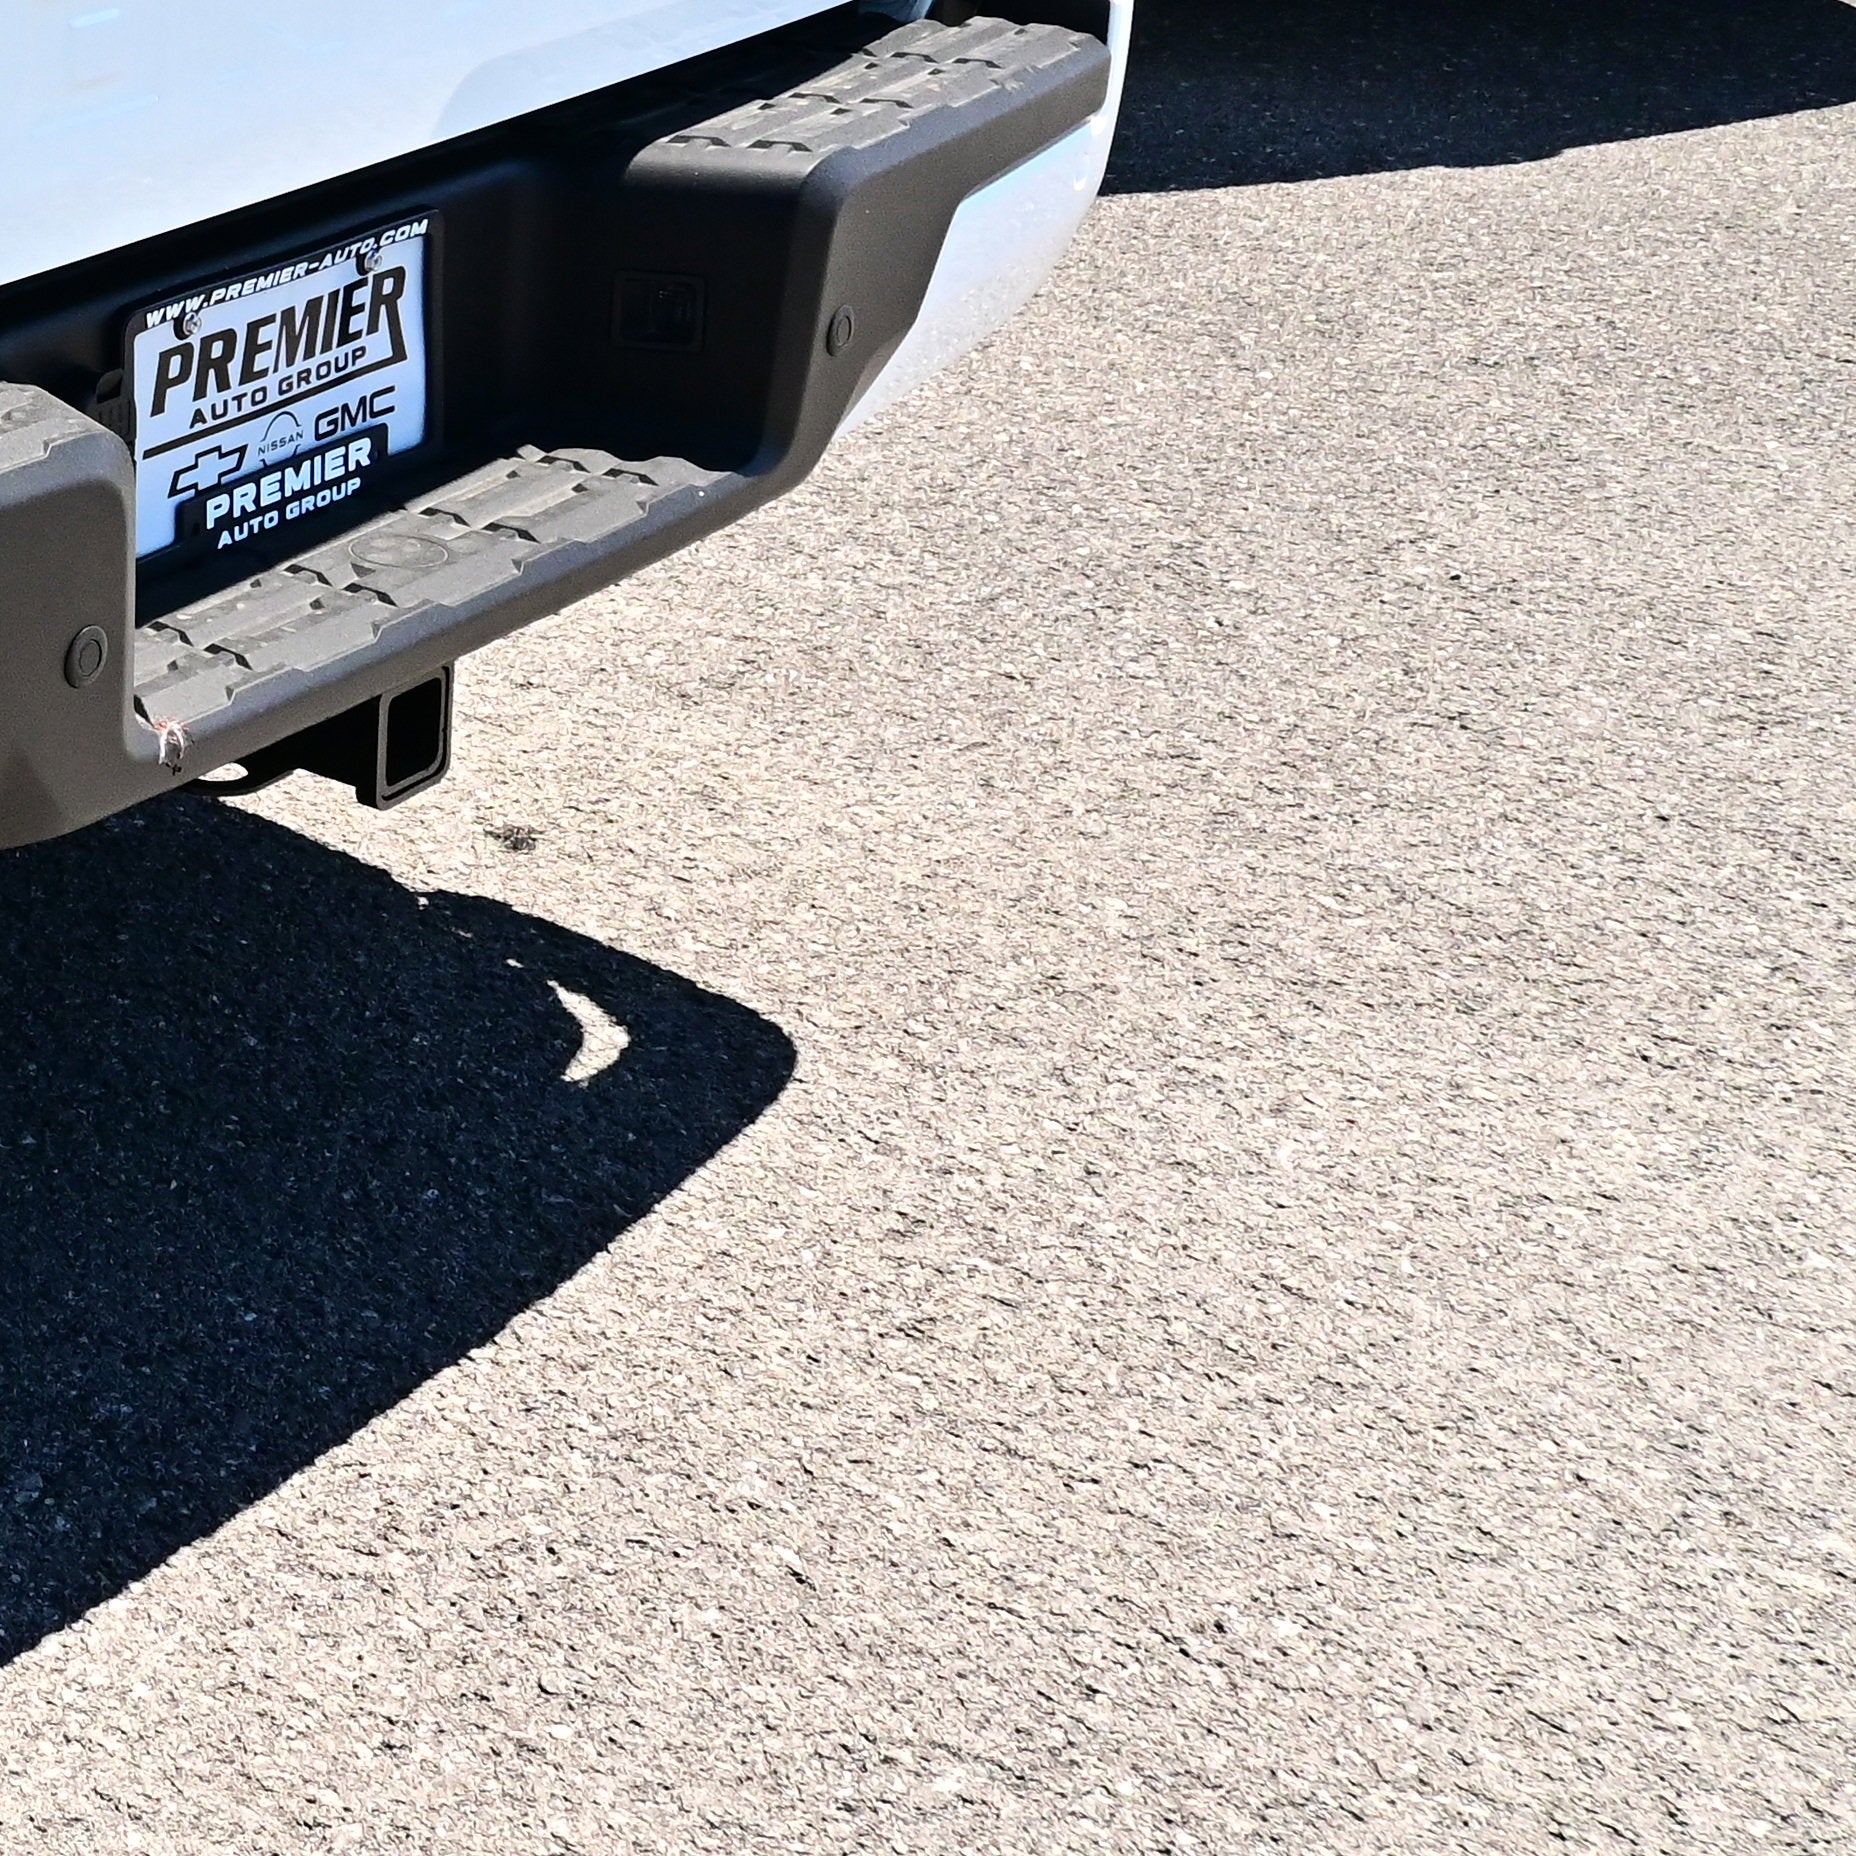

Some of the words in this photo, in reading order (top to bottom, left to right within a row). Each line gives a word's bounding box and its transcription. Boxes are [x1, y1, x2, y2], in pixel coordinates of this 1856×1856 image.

[149, 264, 407, 418] PREMIER
[189, 385, 268, 430] AUTO
[277, 345, 367, 398] GROUP
[314, 384, 396, 442] GMC
[256, 428, 305, 458] NISSAN
[205, 436, 372, 531] PREMIER
[216, 510, 279, 550] AUTO
[285, 477, 362, 521] GROUP
